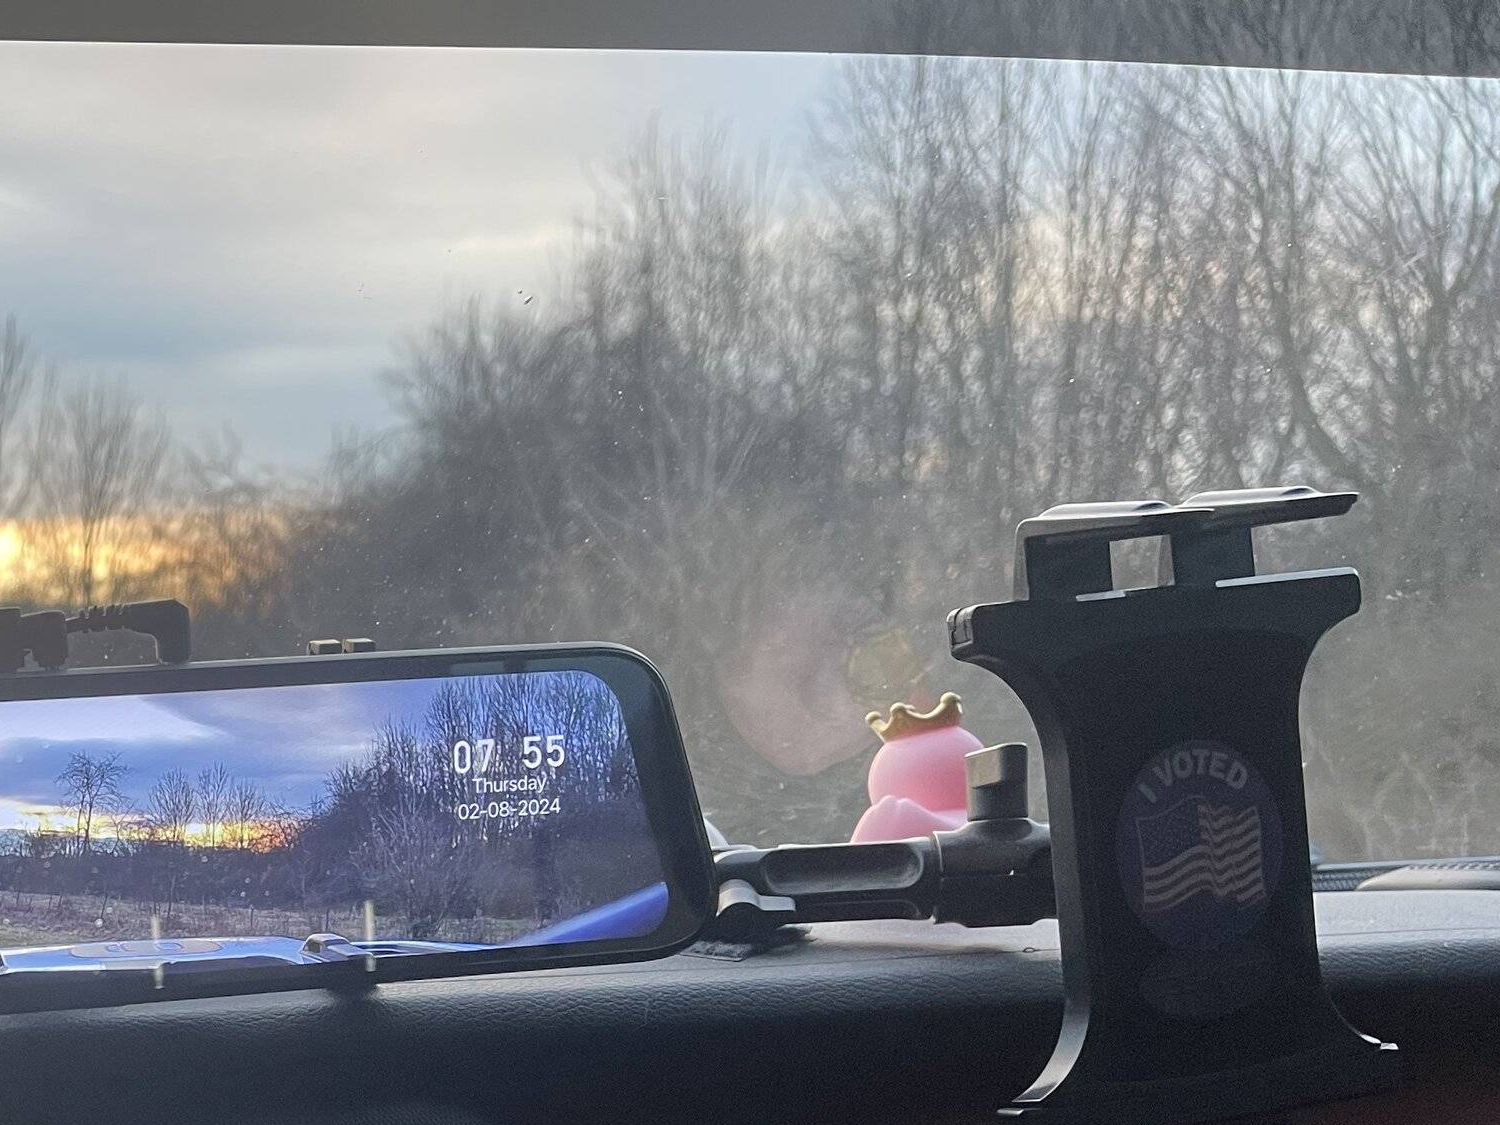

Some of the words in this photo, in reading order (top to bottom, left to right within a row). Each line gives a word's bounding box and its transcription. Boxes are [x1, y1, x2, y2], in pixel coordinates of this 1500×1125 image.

[1154, 751, 1249, 790] VOTED
[473, 776, 547, 793] Thursday
[458, 798, 561, 820] 02-08-2024
